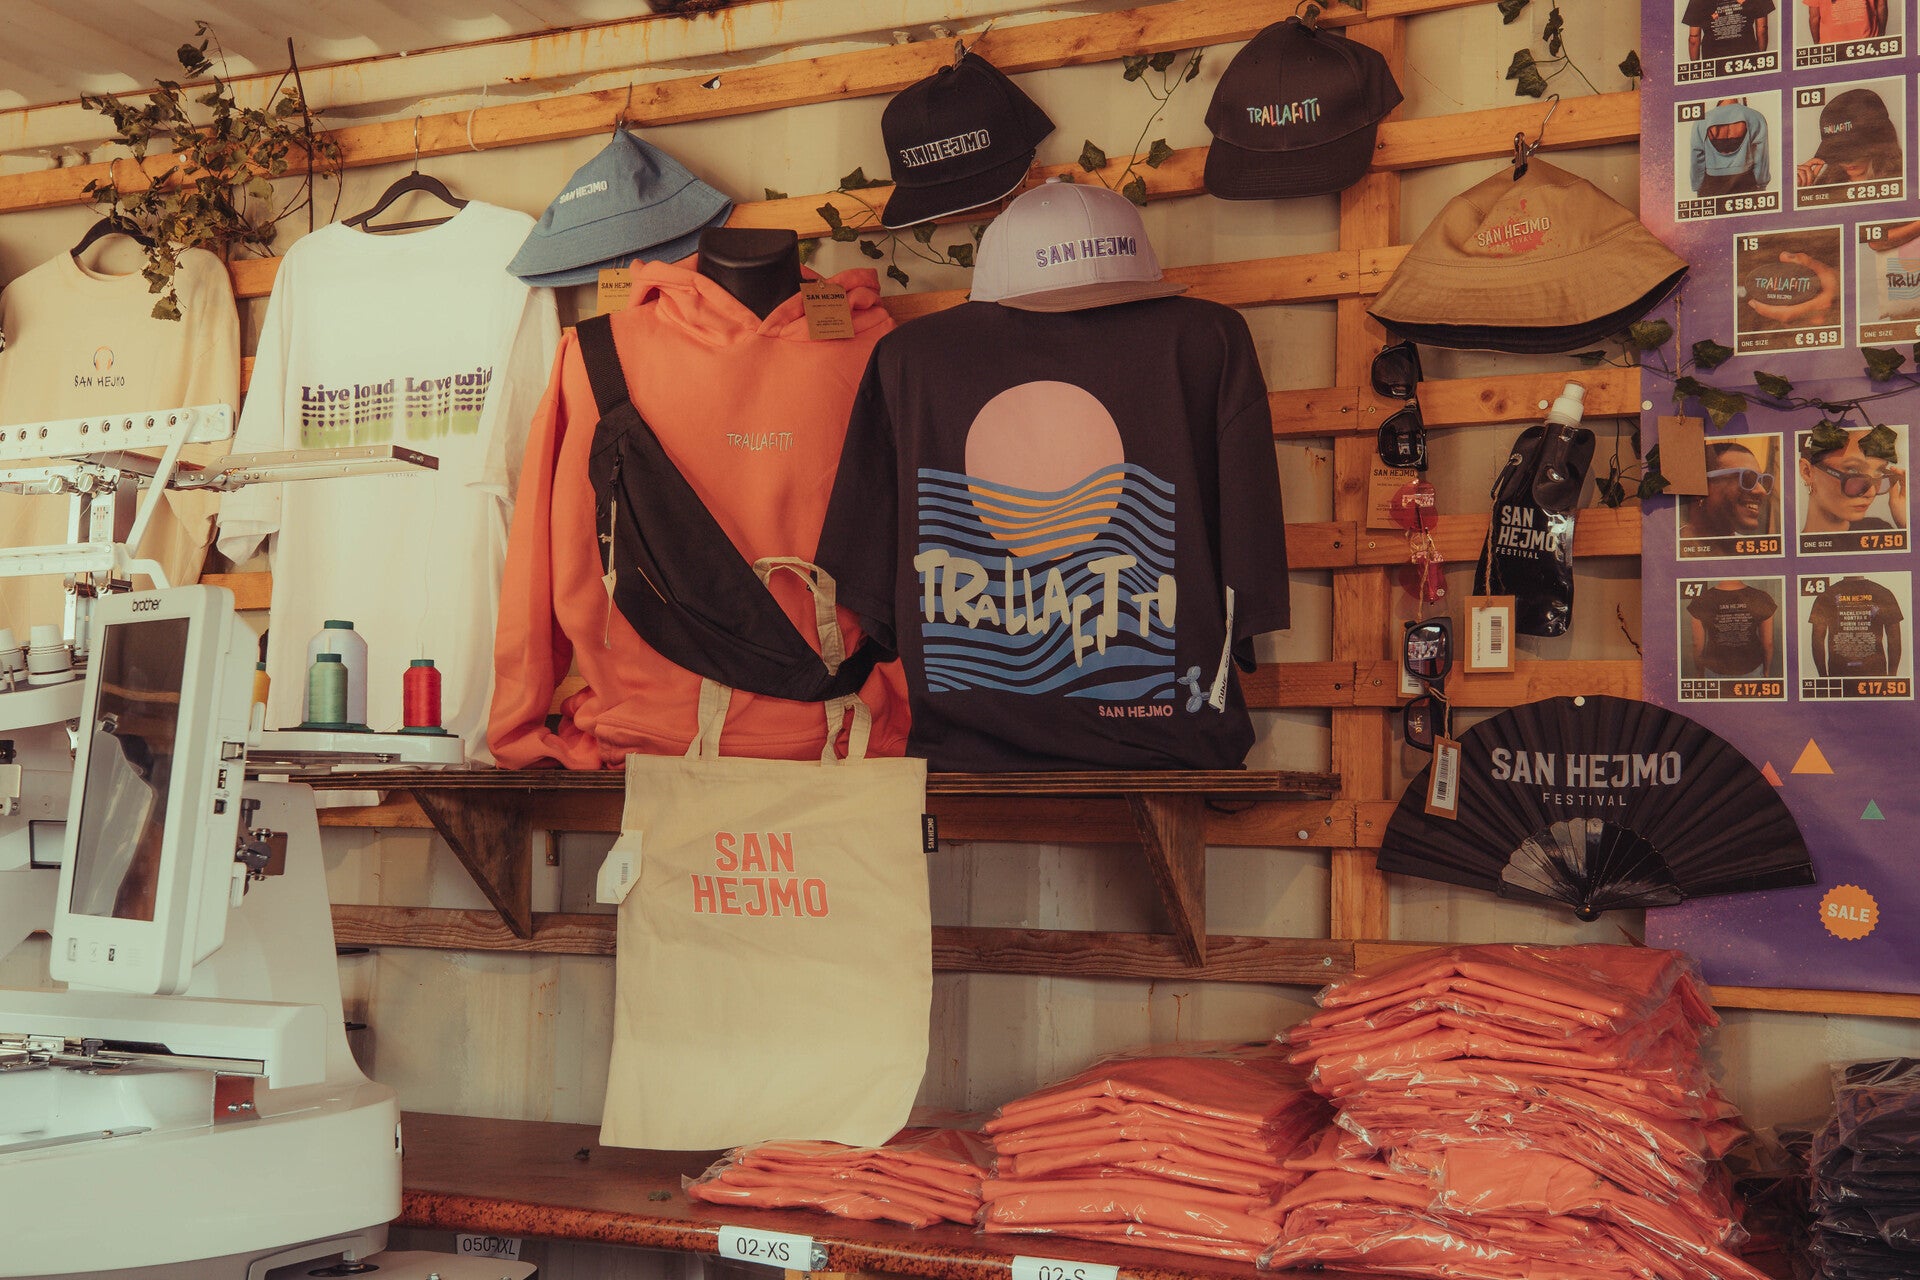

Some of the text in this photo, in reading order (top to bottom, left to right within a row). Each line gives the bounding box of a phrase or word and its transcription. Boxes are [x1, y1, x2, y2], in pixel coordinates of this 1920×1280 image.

[1846, 40, 1899, 58] €34,99
[1724, 56, 1774, 73] €34,99
[1801, 91, 1820, 104] 09
[1247, 98, 1320, 127] TRALLAFITTI
[1682, 106, 1700, 119] 08
[900, 129, 990, 167] SAN HEJMO
[1847, 183, 1900, 200] €29,99
[1477, 217, 1550, 246] SAN HEJMO
[1866, 227, 1882, 240] 16
[1035, 236, 1137, 268] SAN HEJMO
[1743, 238, 1759, 250] 15
[1755, 277, 1810, 292] TRALLAFITTI
[1795, 331, 1838, 346] €9,99
[74, 375, 92, 387] SAN
[301, 366, 493, 403] Live loud Love wild
[726, 432, 793, 451] TRALLAFITTI
[1501, 505, 1534, 528] SAN
[1498, 526, 1557, 552] HEJMO
[1860, 535, 1903, 548] €7,50
[1496, 547, 1539, 559] FESTIVAL
[1685, 584, 1703, 597] 47
[1805, 580, 1825, 593] 48
[132, 598, 161, 612] brother
[1734, 683, 1780, 696] €17,50
[1857, 682, 1906, 695] €17,50
[1098, 704, 1173, 717] SAN HEJMO
[1491, 747, 1556, 786] SAN
[1566, 751, 1682, 788] HEJMO
[1543, 792, 1627, 807] FESTIVAL
[714, 831, 796, 873] SAN
[690, 874, 831, 918] HEJMO
[1827, 903, 1870, 923] SALE
[736, 1237, 790, 1261] 02-XS
